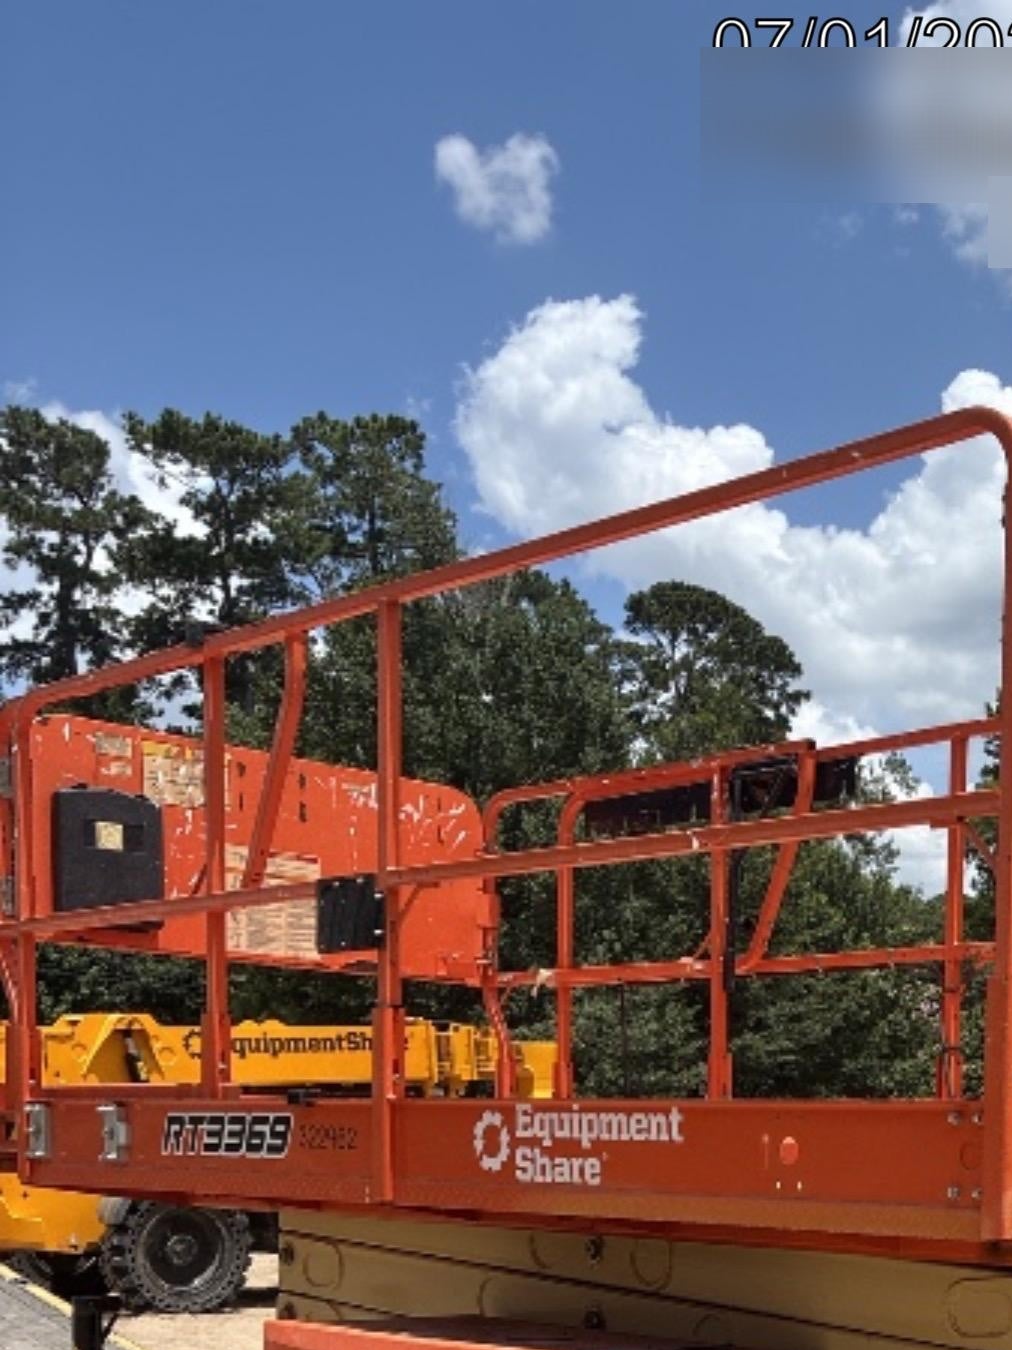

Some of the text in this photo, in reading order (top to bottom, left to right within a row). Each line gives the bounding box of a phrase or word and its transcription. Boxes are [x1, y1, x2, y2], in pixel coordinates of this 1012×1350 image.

[161, 1112, 295, 1159] RT3369
[515, 1103, 684, 1149] Equipment
[515, 1146, 601, 1185] Share
